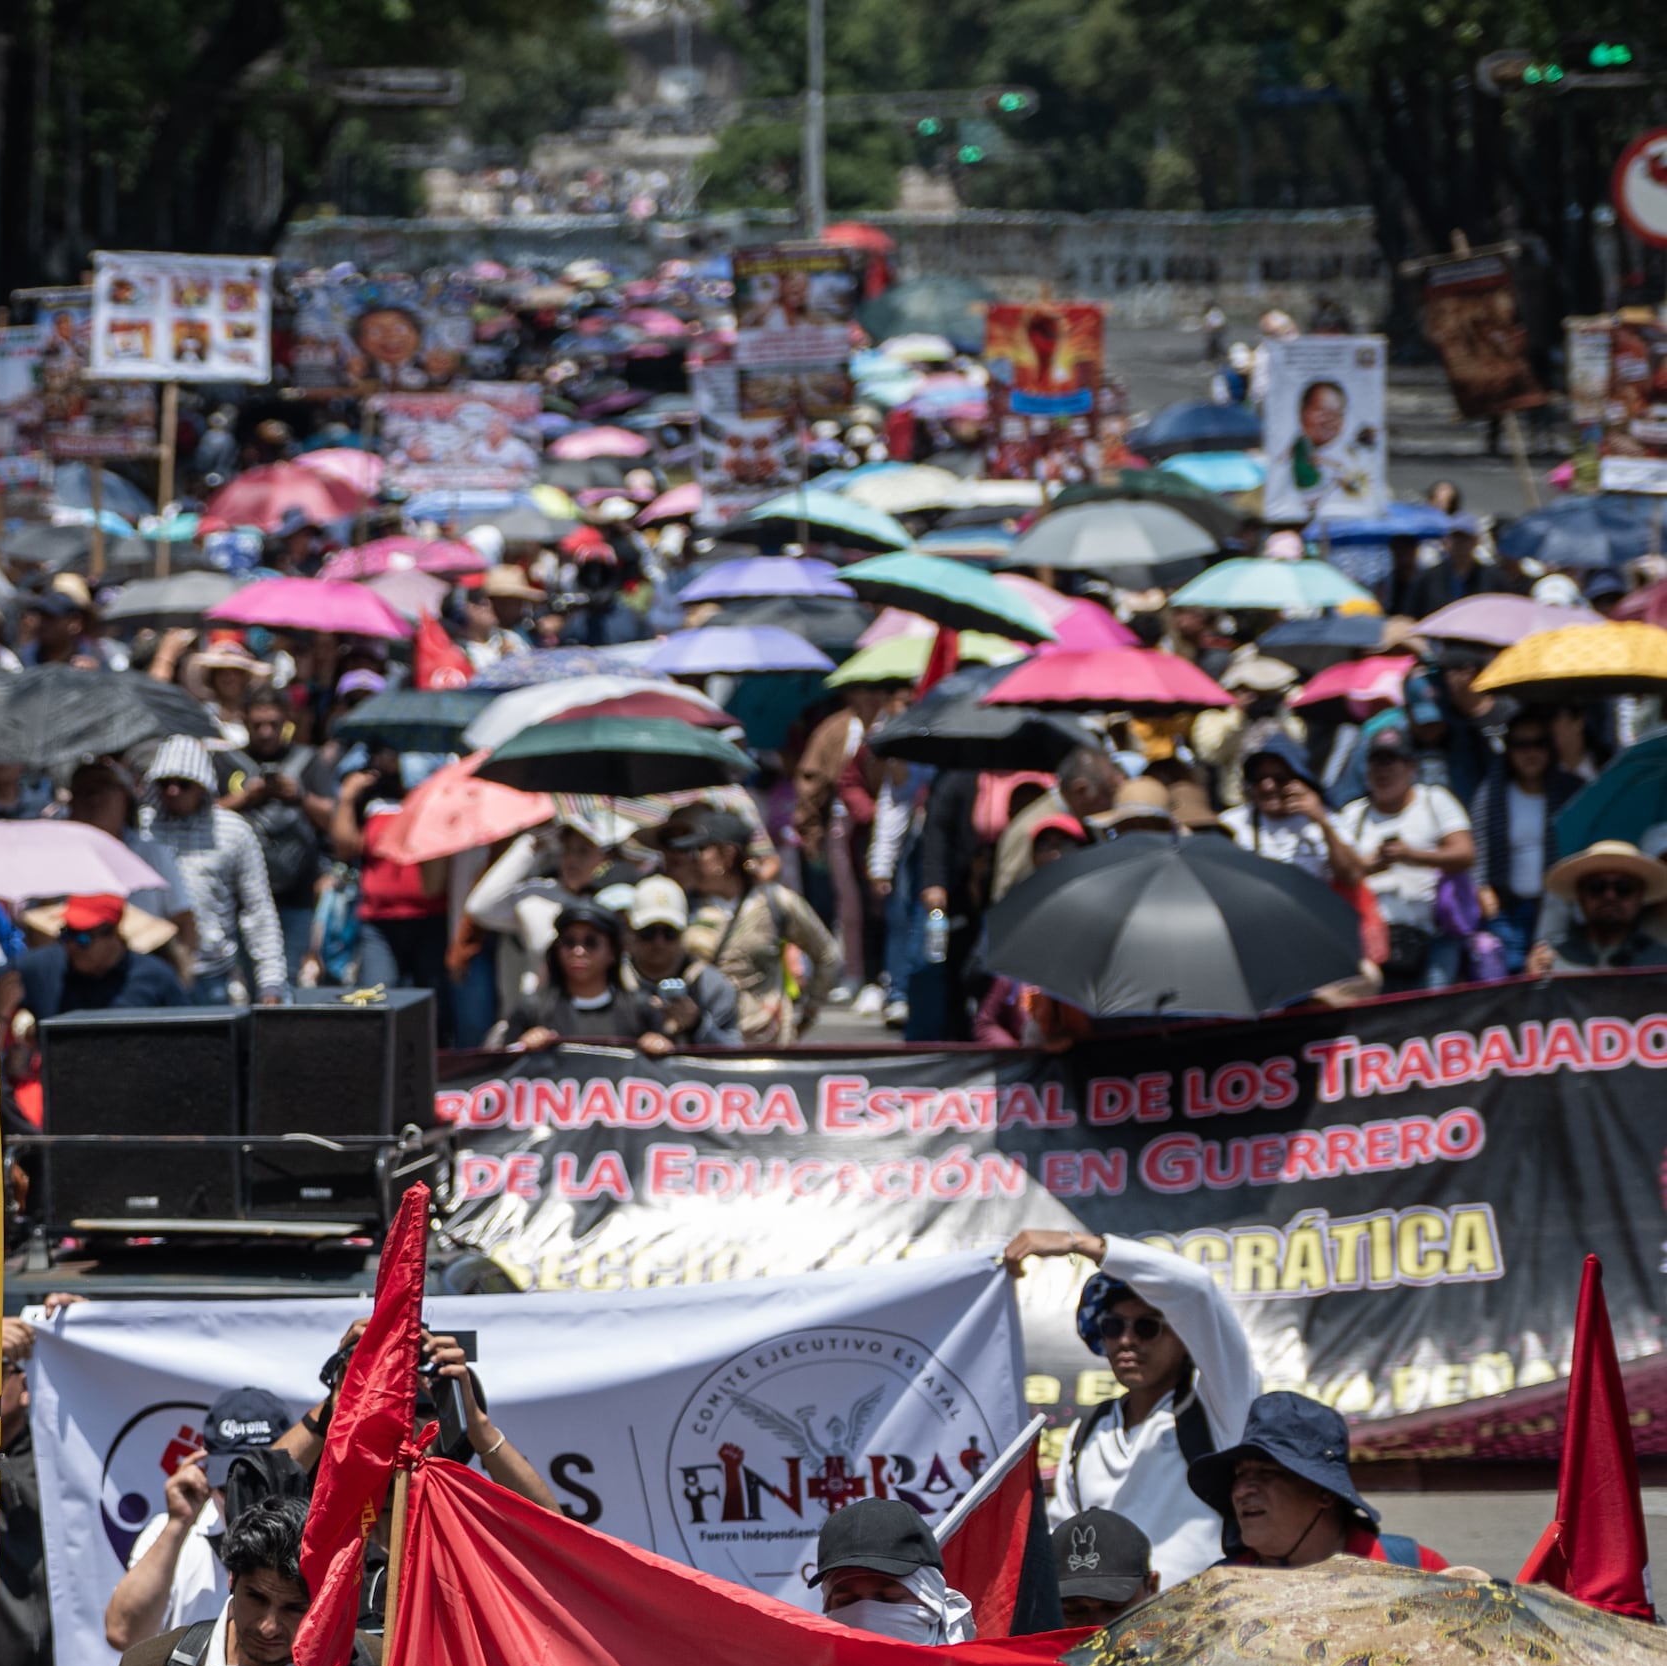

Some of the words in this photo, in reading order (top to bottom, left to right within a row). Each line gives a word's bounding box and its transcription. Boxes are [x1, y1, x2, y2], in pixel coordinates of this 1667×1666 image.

[817, 1073, 1077, 1136] ESTATAL
[1088, 1071, 1173, 1126] DE
[1183, 1055, 1300, 1117] LOS
[457, 1151, 541, 1200] DE
[556, 1149, 633, 1201] LA
[645, 1142, 1027, 1200] EDUCACIÓN
[1041, 1148, 1127, 1197] EN
[1138, 1106, 1486, 1194] GUERRERO
[1127, 1203, 1505, 1298] CRÁTICA
[692, 1366, 747, 1436] COMITÉ
[753, 1337, 883, 1369] EJECUTIVO
[893, 1347, 962, 1422] ESTATAL
[742, 1528, 826, 1543] Independient
